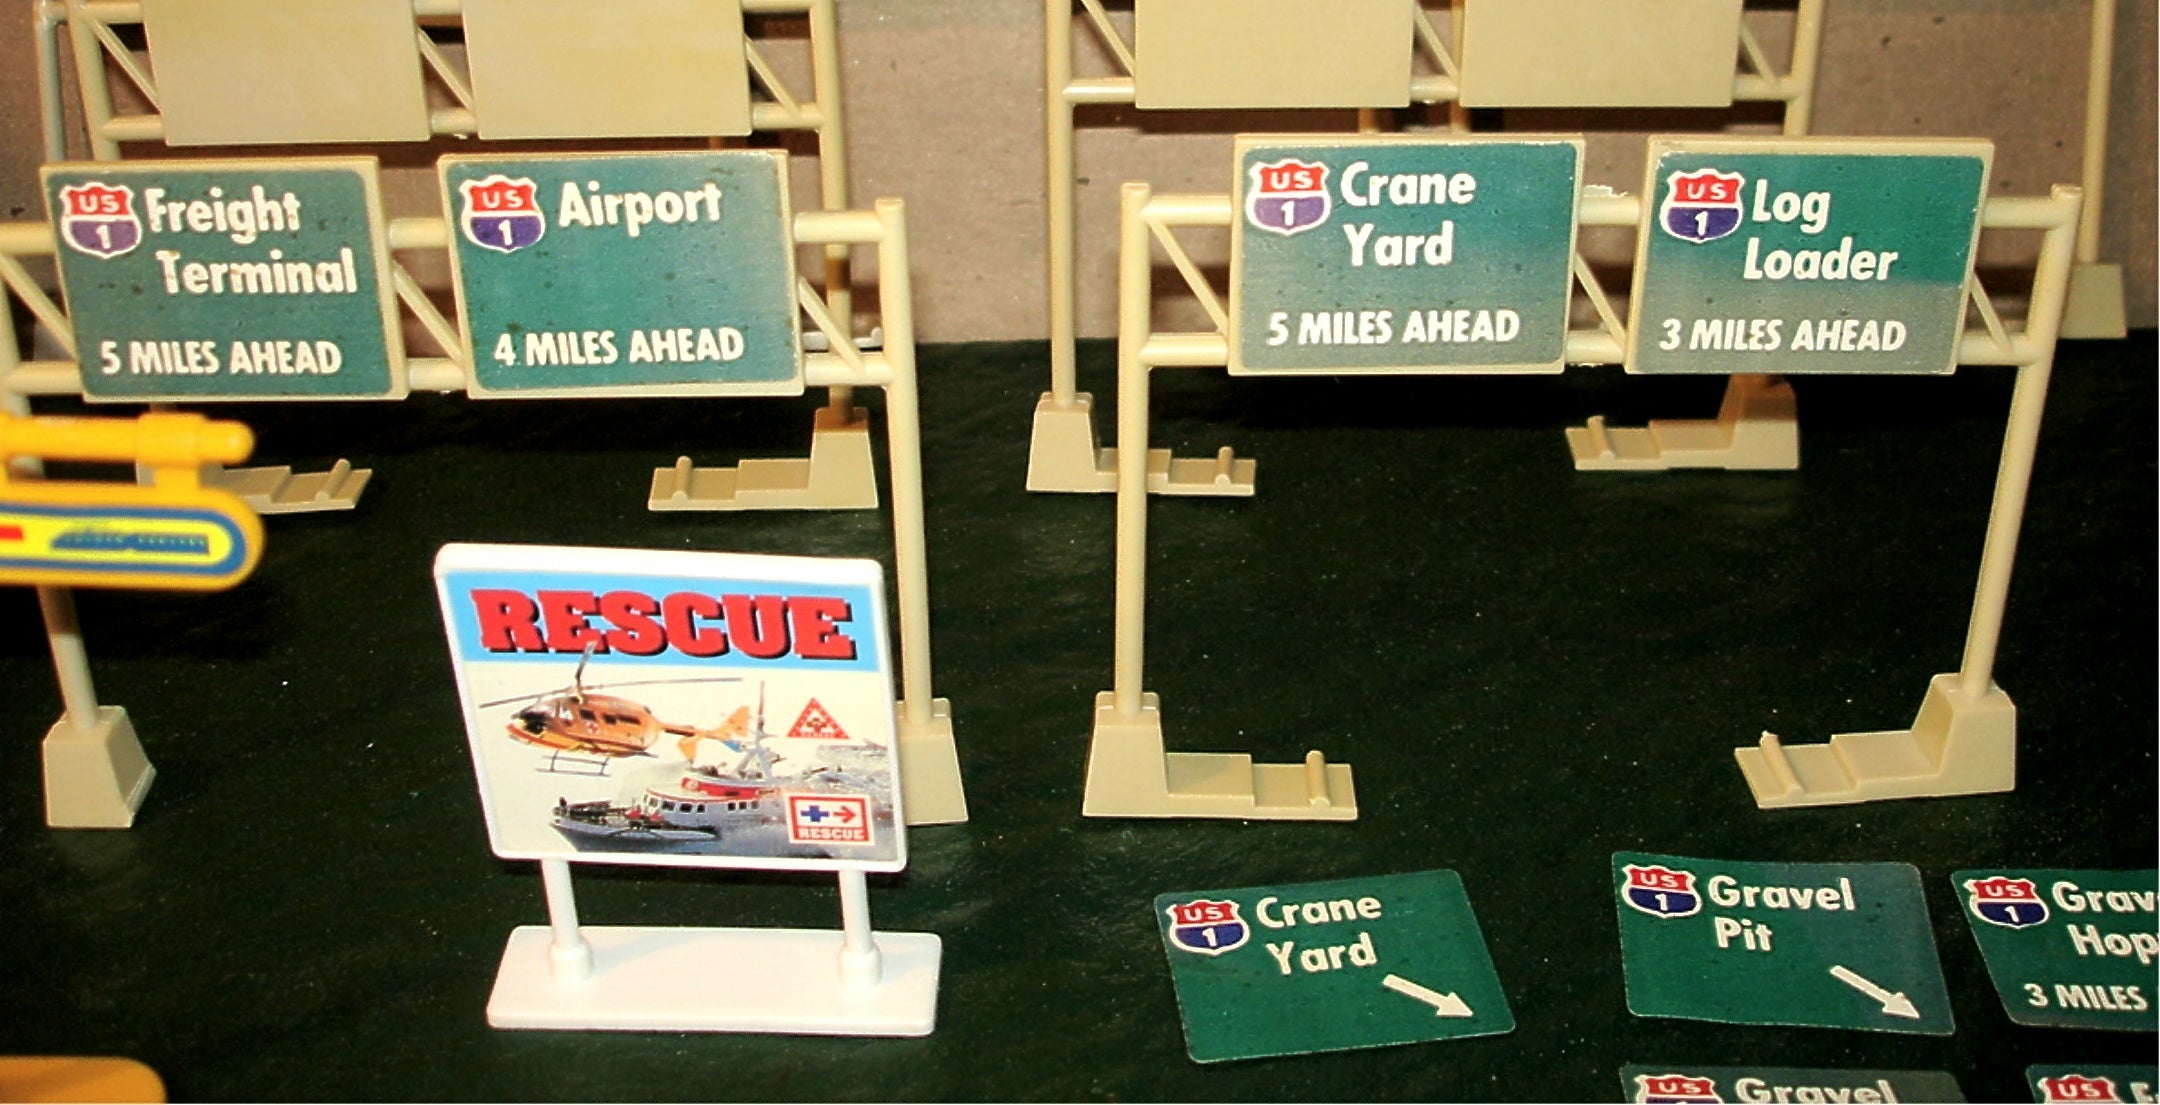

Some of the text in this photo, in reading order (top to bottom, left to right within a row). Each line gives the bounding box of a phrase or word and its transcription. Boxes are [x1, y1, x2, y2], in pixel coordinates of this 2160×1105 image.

[1269, 171, 1313, 191] US
[1340, 161, 1477, 206] Crane
[1687, 182, 1728, 200] US
[79, 193, 121, 214] US
[483, 191, 523, 210] US
[558, 180, 722, 238] Airport
[1281, 200, 1295, 226] 1
[1752, 179, 1831, 234] Log
[144, 186, 301, 244] Freight
[1694, 210, 1709, 237] 1
[96, 224, 111, 250] 1
[498, 219, 513, 246] 1
[1343, 220, 1454, 267] Yard
[155, 247, 358, 294] Terminal
[1743, 236, 1899, 281] Loader
[1266, 309, 1520, 345] 5 MILES AHEAD
[1659, 317, 1907, 352] 3 MILES AHEAD
[102, 341, 343, 375] 5 MILES AHEAD
[494, 327, 745, 366] 4 MILES AHEAD
[470, 589, 857, 661] RESCUE
[799, 828, 864, 840] RESCUE
[1641, 874, 1679, 889] US
[1708, 875, 1856, 911] Gravel
[1985, 885, 2025, 899] US
[1654, 893, 1669, 911] 1
[2052, 881, 2158, 912] Grav
[1185, 906, 1223, 922] US
[1256, 897, 1383, 929] Crane
[2004, 905, 2021, 923] 1
[1201, 927, 1218, 947] 1
[1714, 916, 1773, 951] Pit
[2066, 924, 2158, 965] Hop
[1266, 932, 1377, 975] Yard
[2023, 983, 2148, 1011] 3 MILES
[1658, 1081, 1702, 1094] US
[1735, 1077, 1900, 1104] Gravel
[2057, 1083, 2102, 1098] US
